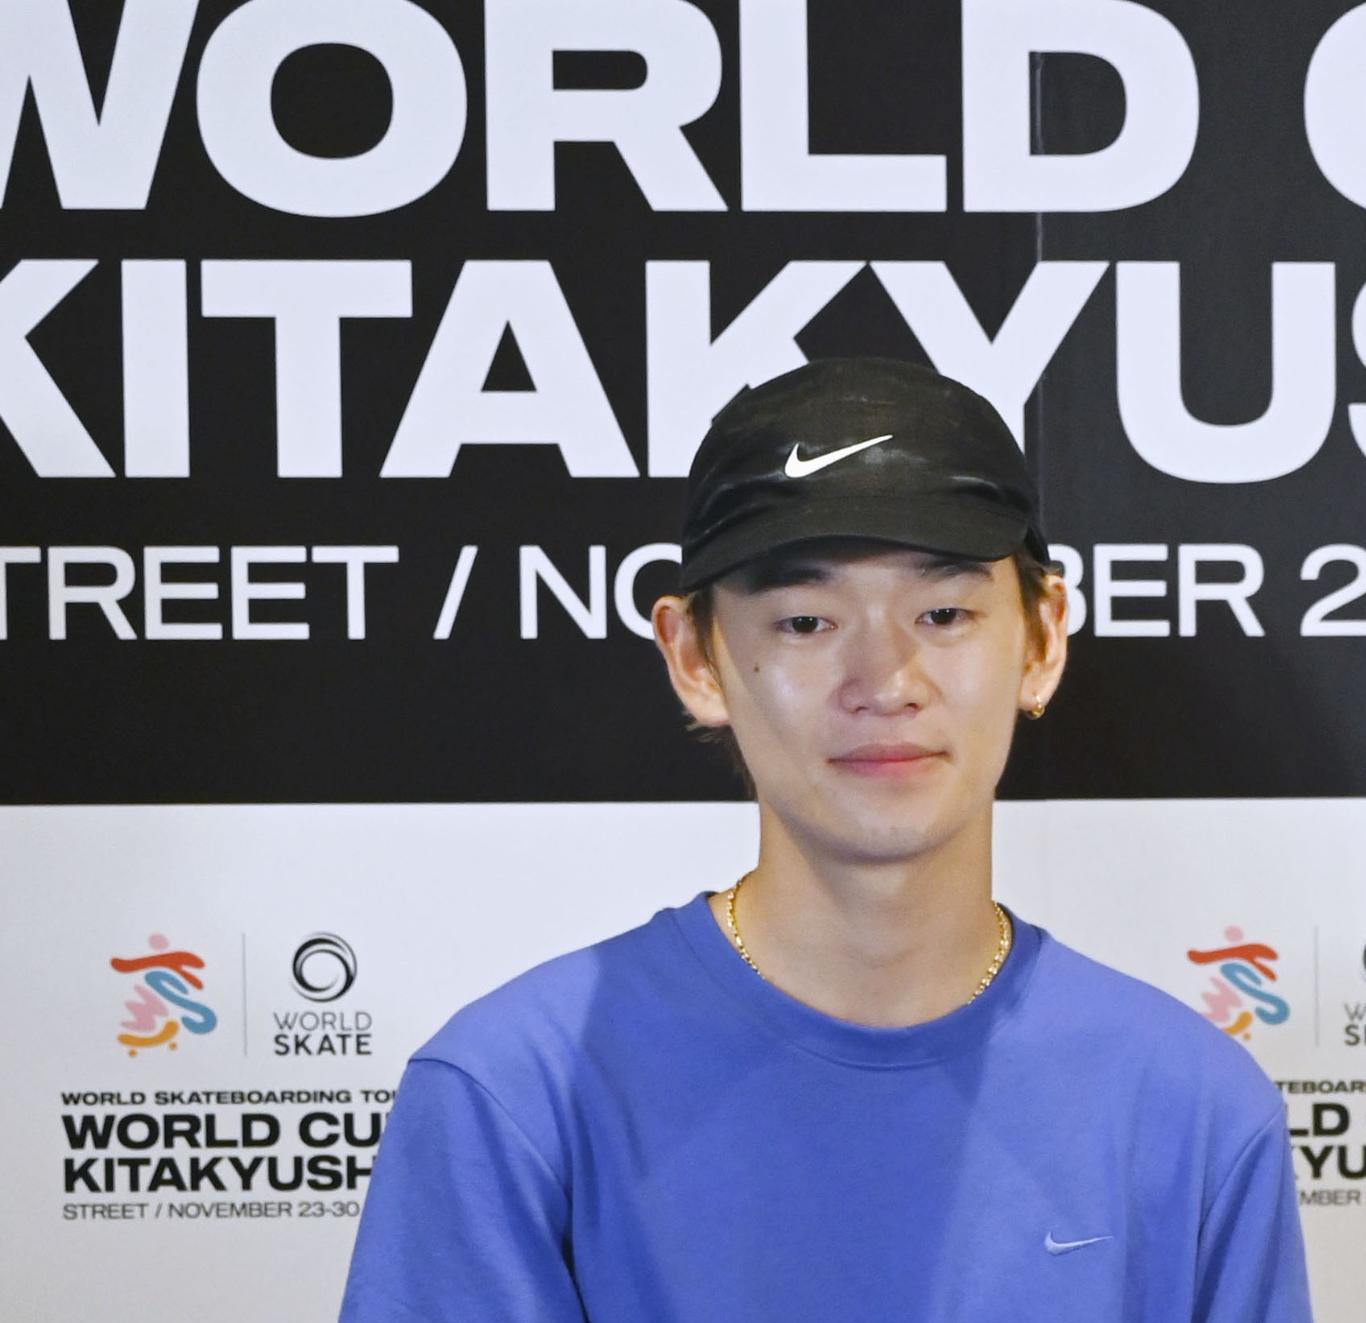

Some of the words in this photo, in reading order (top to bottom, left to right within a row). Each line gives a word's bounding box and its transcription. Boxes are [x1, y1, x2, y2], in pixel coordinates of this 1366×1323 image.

[0, 0, 1199, 217] WORLD
[273, 1011, 373, 1032] WORLD
[273, 1034, 373, 1056] SKATE
[61, 1091, 146, 1106] WORLD
[154, 1090, 351, 1105] SKATEBOARDING
[61, 1113, 281, 1150] WORLD
[299, 1112, 390, 1149] CU
[63, 1155, 376, 1193] KITAKYUSH
[62, 1204, 148, 1221] STREET
[168, 1202, 292, 1219] NOVEMBER
